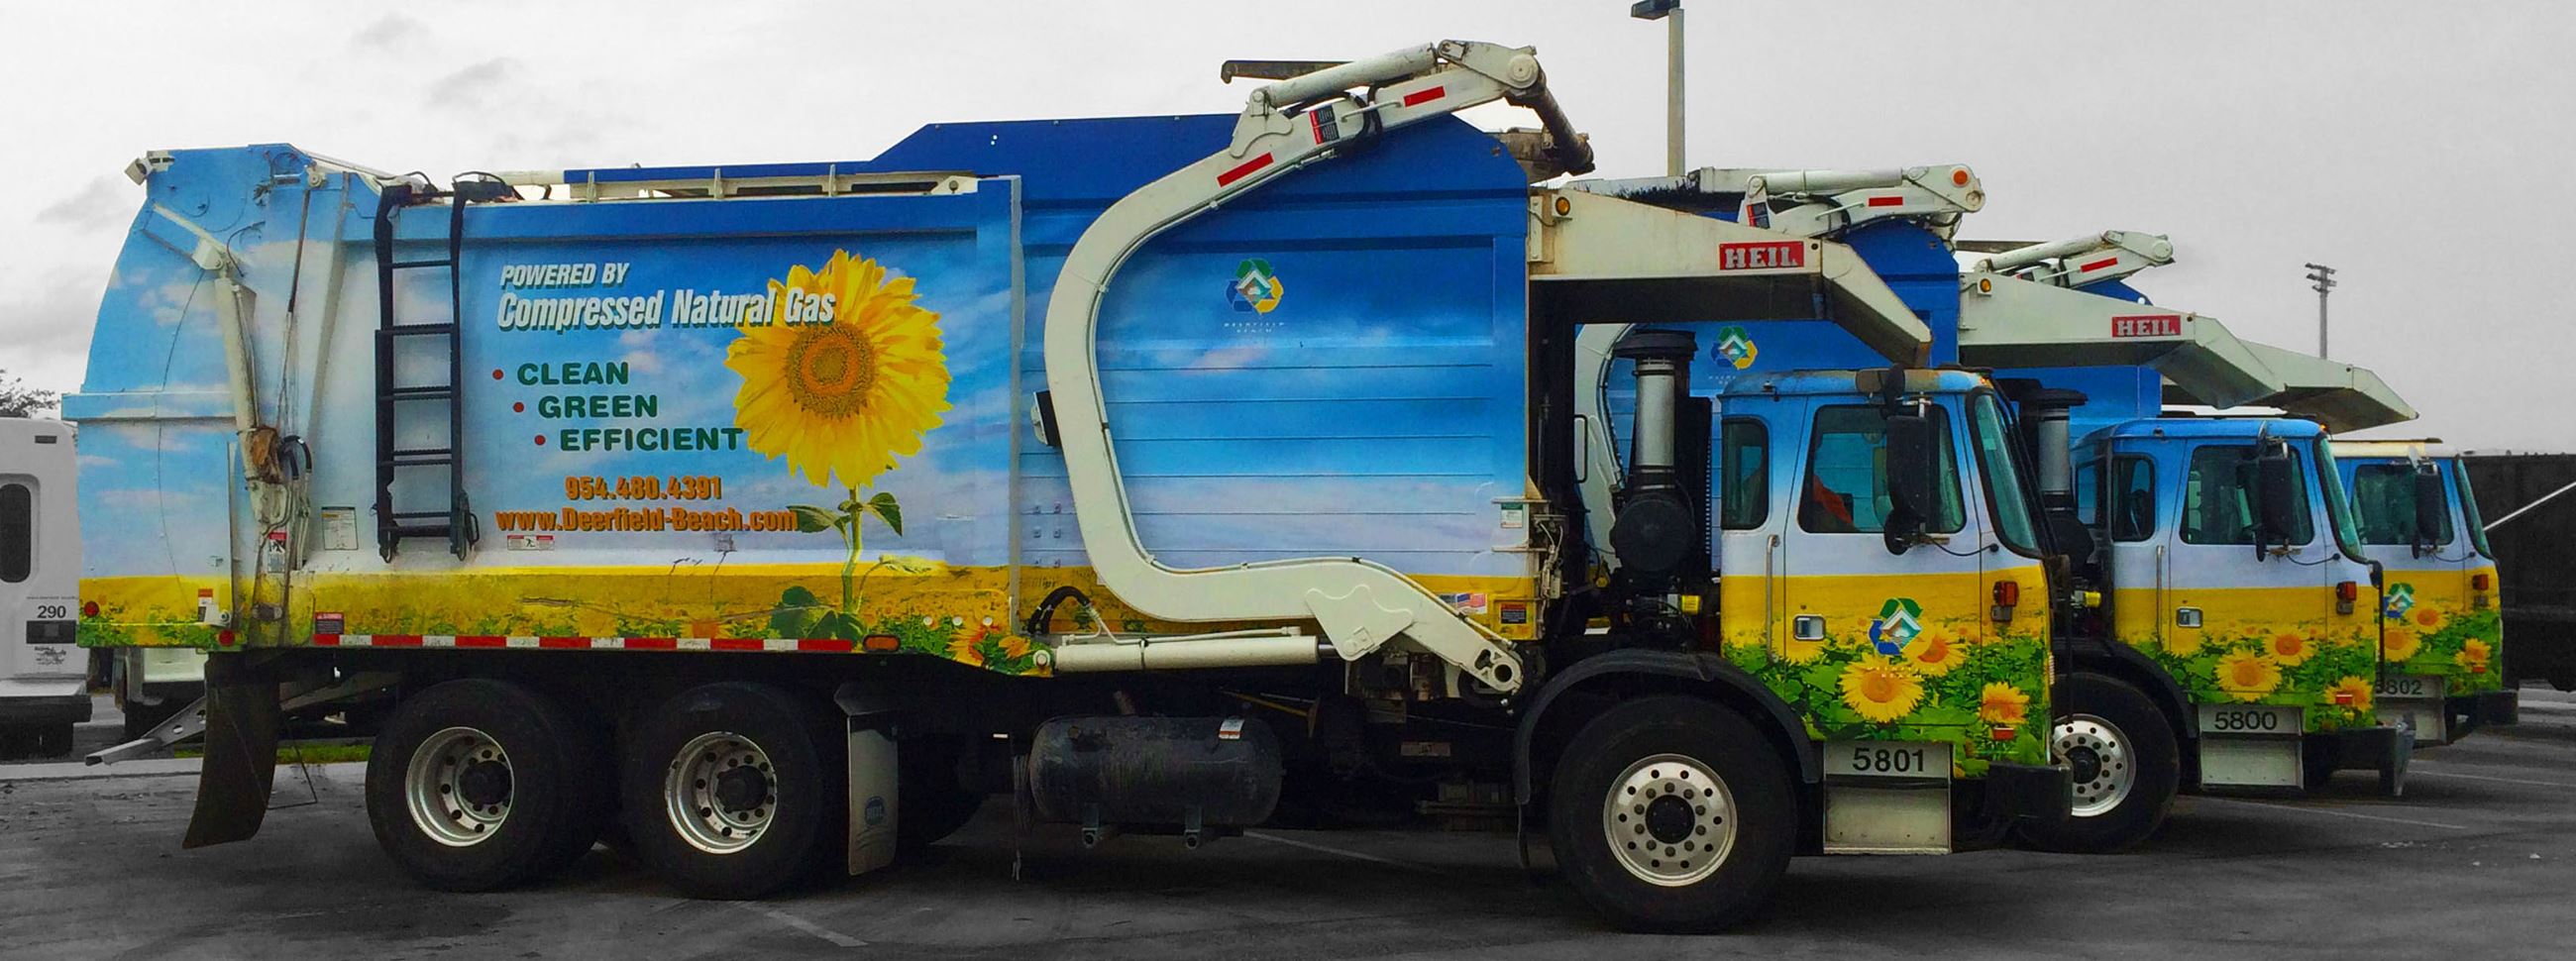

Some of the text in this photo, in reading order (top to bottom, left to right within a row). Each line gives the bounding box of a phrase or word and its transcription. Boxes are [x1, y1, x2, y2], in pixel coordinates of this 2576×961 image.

[1725, 247, 1798, 268] HEIL
[499, 263, 630, 287] POWERED BY
[497, 287, 835, 334] Compressed Natural Gas
[2116, 319, 2176, 336] HEIL
[517, 362, 629, 385] CLEAN
[538, 394, 658, 418] GREEN
[560, 427, 744, 451] EFFICIENT
[565, 476, 721, 499] 954.480.4391
[495, 506, 799, 532] www.Deerfield-Beach.com
[37, 605, 66, 619] 290
[2214, 710, 2278, 730] 5800
[1852, 747, 1924, 772] 5801
